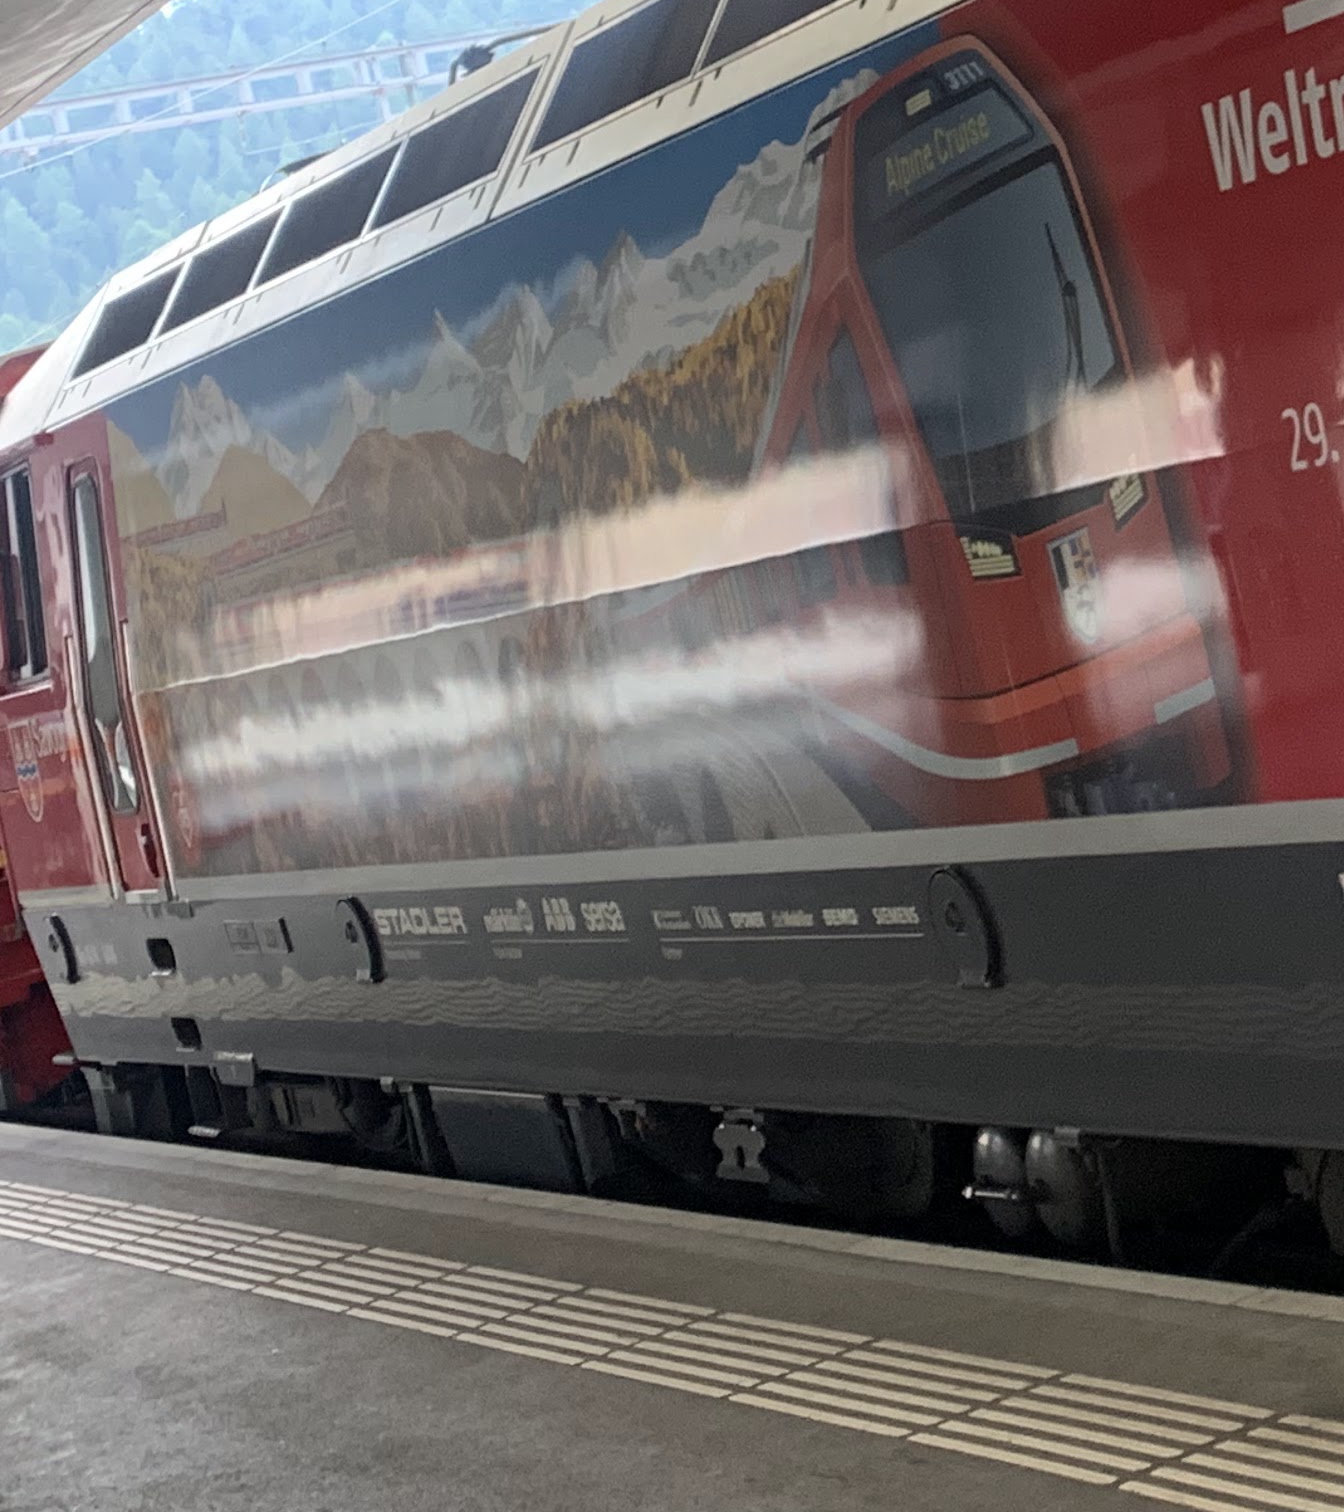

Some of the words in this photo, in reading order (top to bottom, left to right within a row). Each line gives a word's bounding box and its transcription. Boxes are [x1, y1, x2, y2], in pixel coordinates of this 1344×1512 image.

[885, 143, 936, 197] Alpine
[933, 111, 990, 164] Cruise
[1281, 403, 1340, 473] 29.
[373, 905, 468, 935] STADLER
[541, 897, 577, 932] ABB
